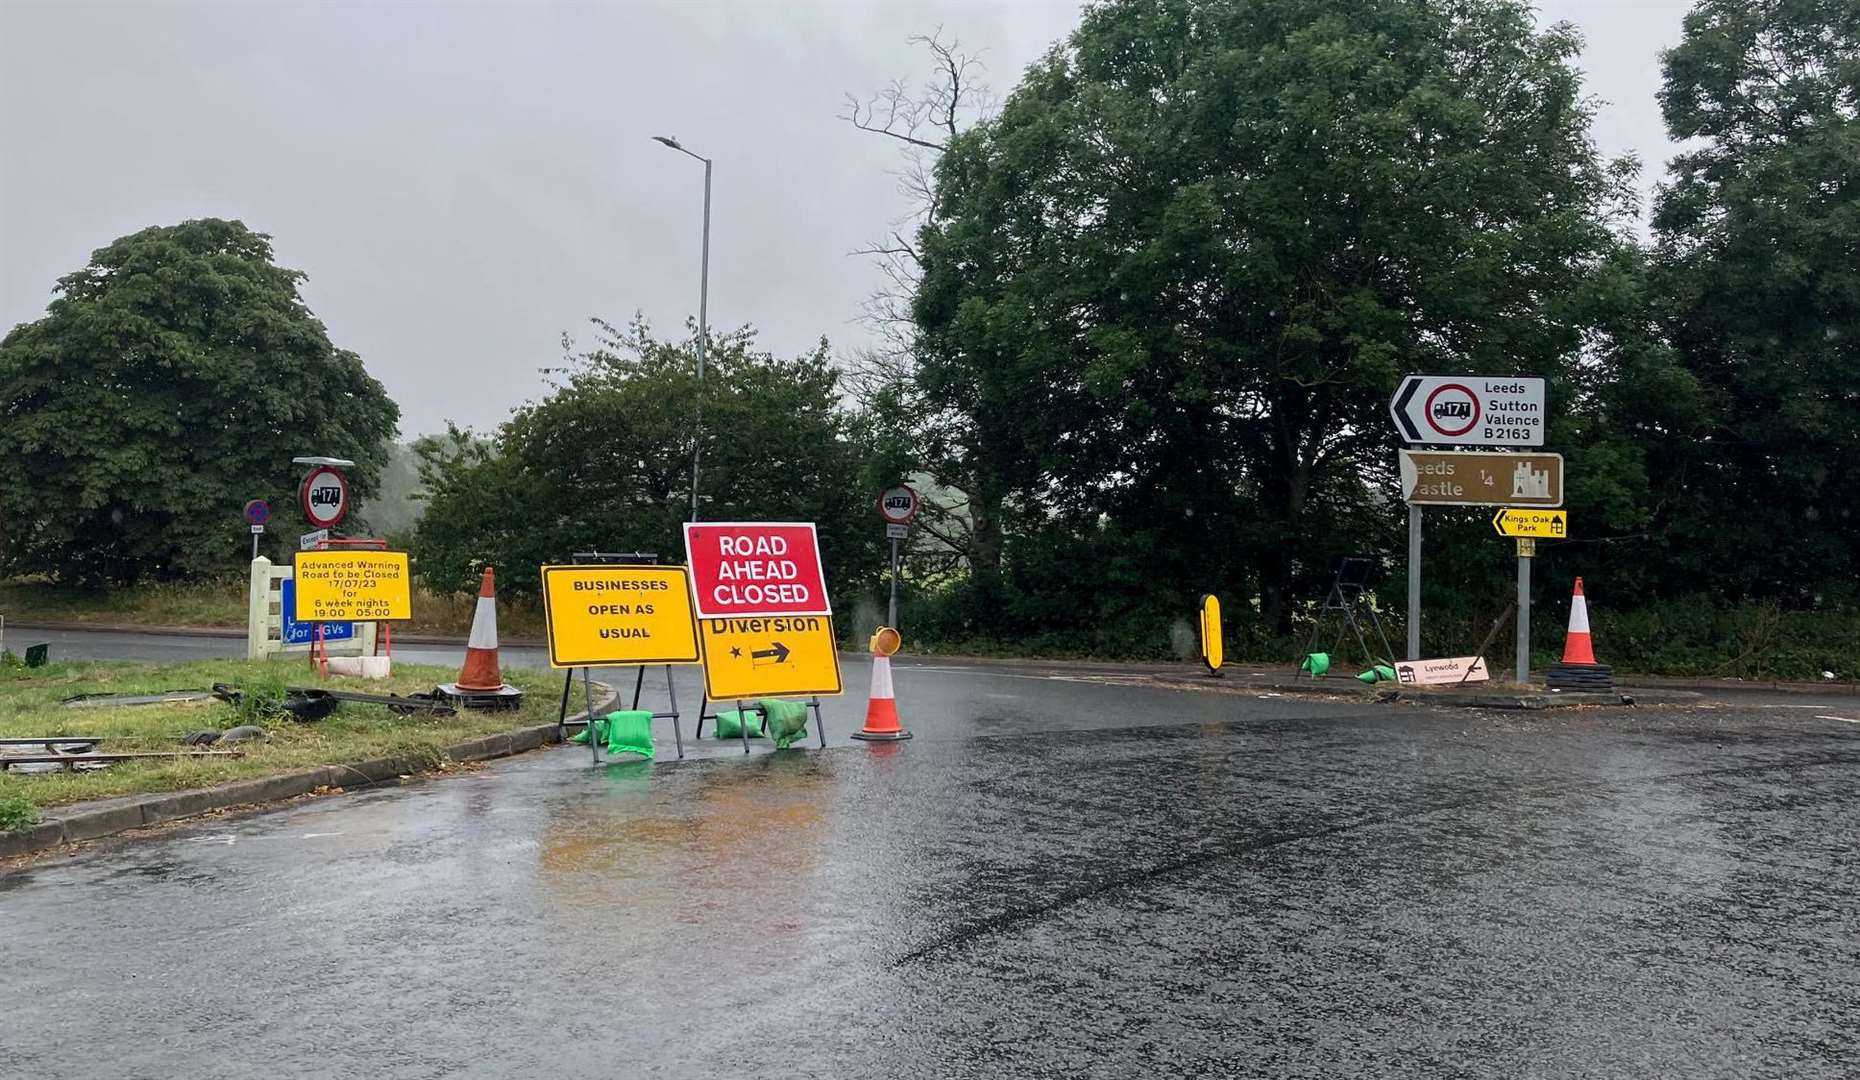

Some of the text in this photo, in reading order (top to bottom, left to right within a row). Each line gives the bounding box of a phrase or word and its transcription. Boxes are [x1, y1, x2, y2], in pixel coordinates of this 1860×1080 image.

[1485, 382, 1525, 394] Leeds
[1489, 400, 1538, 412] Sutton
[1485, 414, 1539, 426] Valence
[1415, 460, 1455, 476] eeds
[1413, 481, 1464, 497] astle
[1505, 515, 1550, 524] Kings Oak
[719, 535, 787, 556] ROAD
[301, 561, 400, 570] Advanced Warning
[718, 560, 798, 580] AHEAD
[302, 570, 399, 579] Road to be Closed
[329, 580, 377, 589] 17/07/23
[573, 581, 668, 591] BUSINESSES
[343, 589, 357, 597] for
[713, 584, 809, 605] CLOSED
[315, 599, 390, 608] 6 week nights
[314, 609, 345, 617] 19:00
[356, 608, 390, 617] 05:00
[588, 604, 655, 615] OPEN AS
[711, 617, 820, 634] Diversion
[599, 628, 650, 639] USUAL
